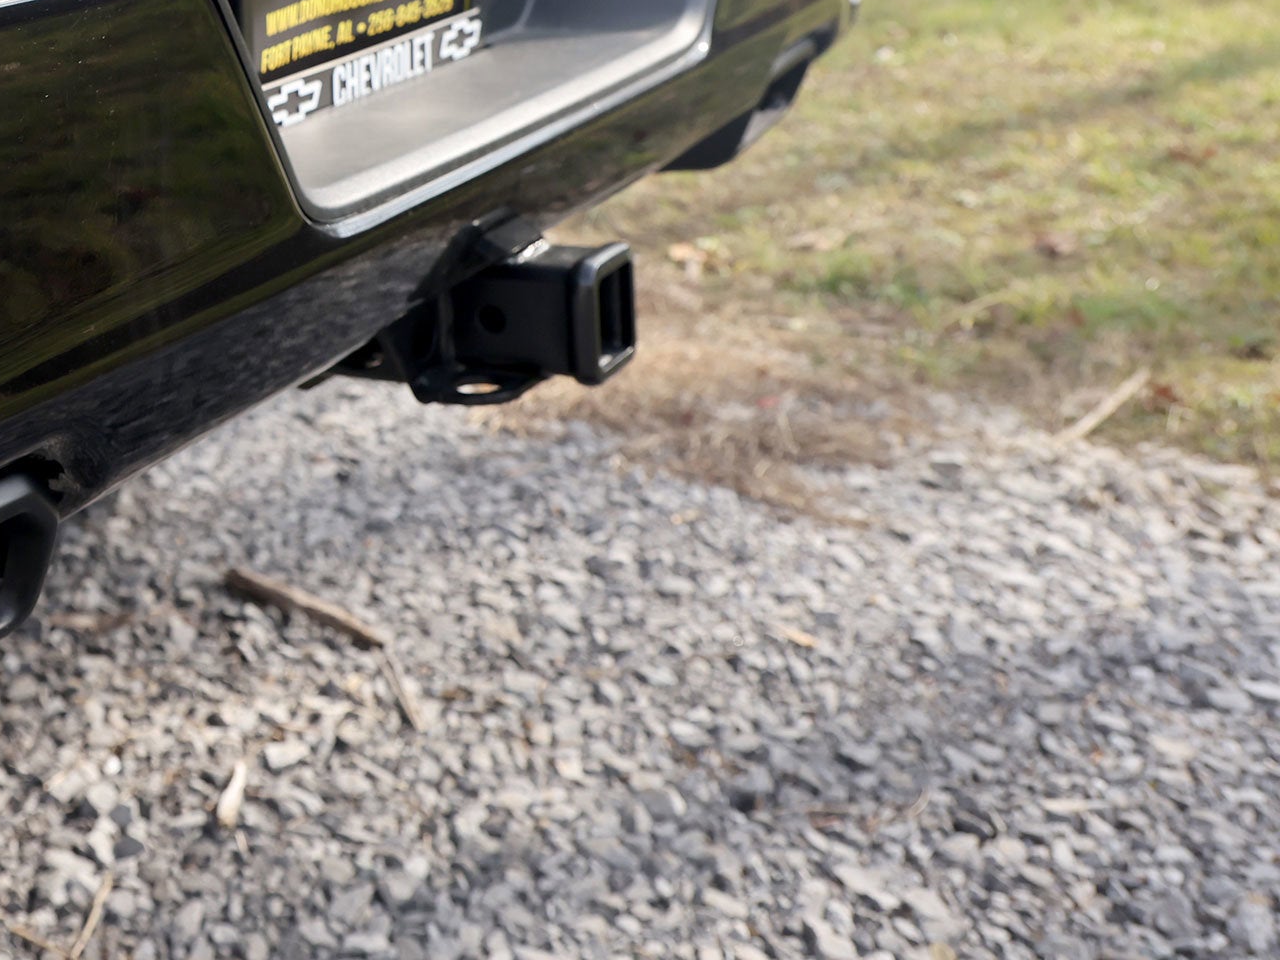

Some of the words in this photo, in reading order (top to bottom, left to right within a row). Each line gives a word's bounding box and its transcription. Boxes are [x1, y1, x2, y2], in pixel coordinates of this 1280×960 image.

[260, 40, 293, 74] FORT
[336, 18, 357, 45] AL
[332, 30, 435, 108] CHEVROLET
